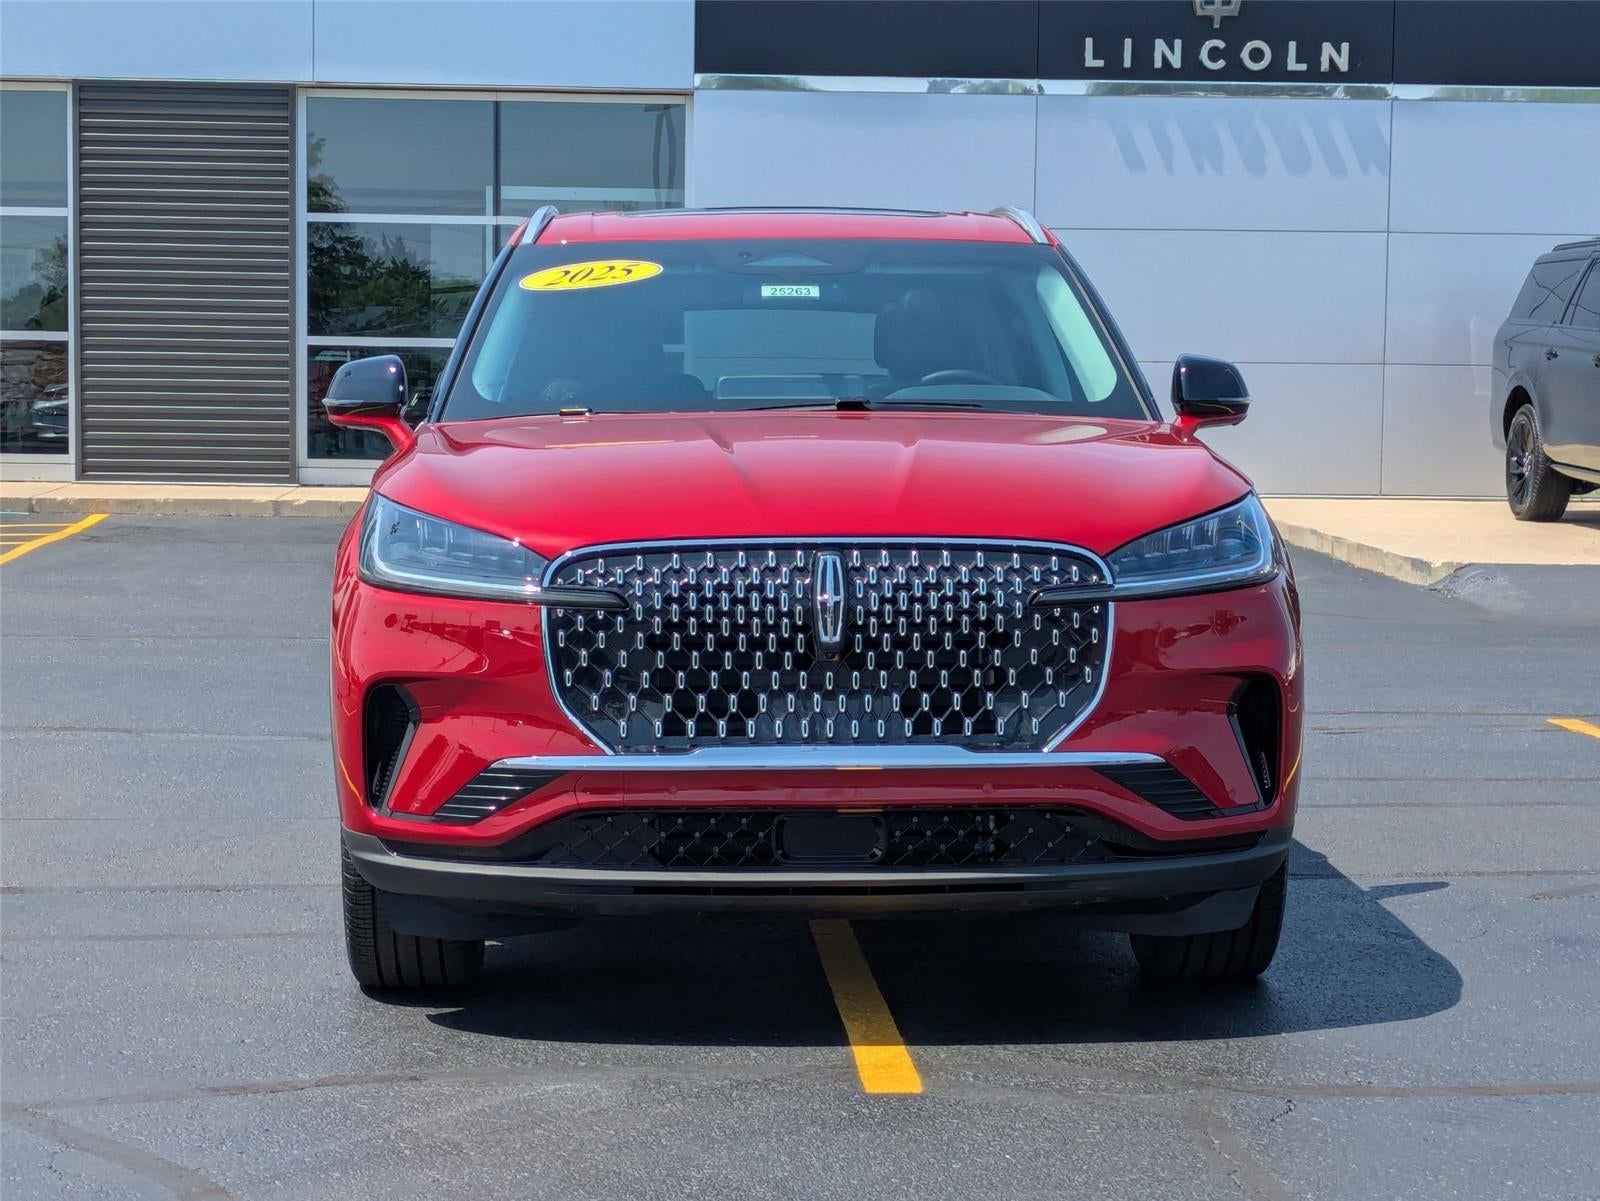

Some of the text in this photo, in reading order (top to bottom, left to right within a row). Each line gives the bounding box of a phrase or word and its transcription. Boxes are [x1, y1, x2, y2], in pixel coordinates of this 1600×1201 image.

[1084, 37, 1350, 73] LINCOLN
[544, 264, 642, 287] 2025
[770, 286, 812, 297] 25263
